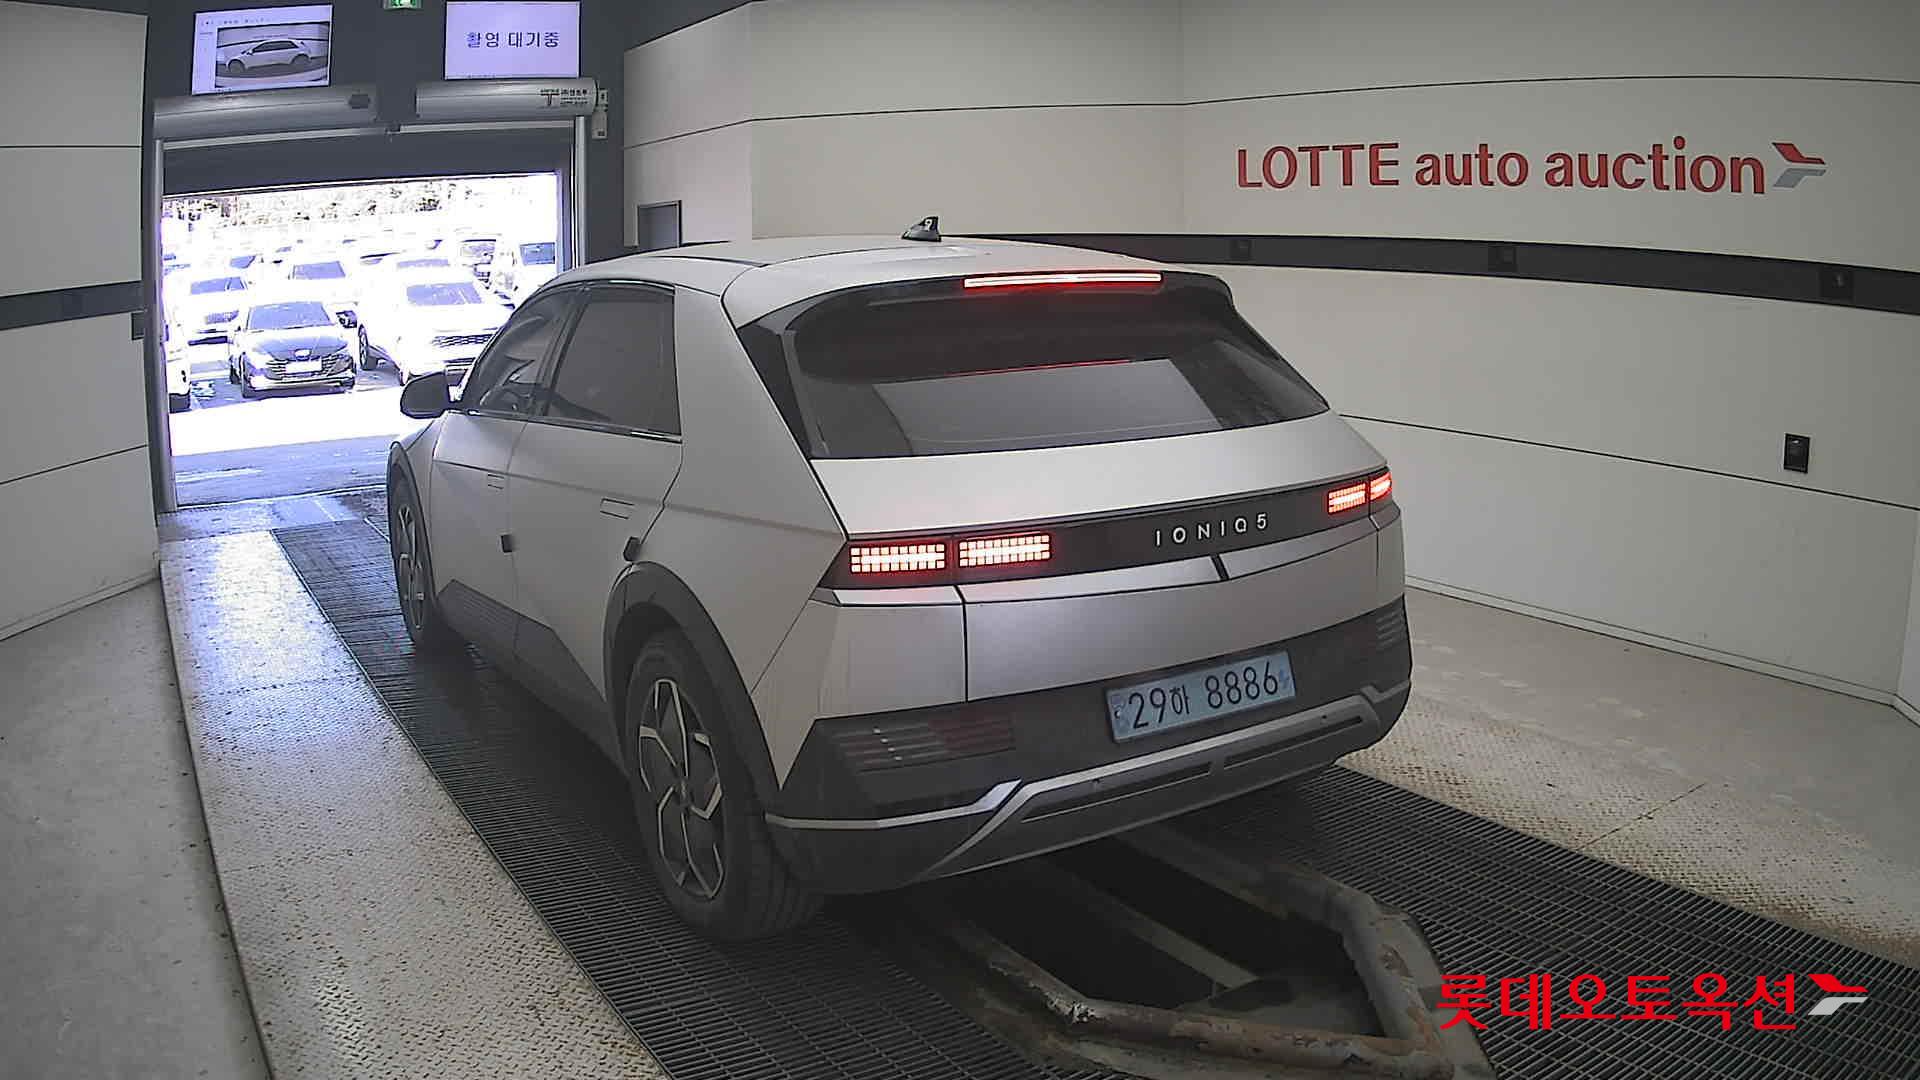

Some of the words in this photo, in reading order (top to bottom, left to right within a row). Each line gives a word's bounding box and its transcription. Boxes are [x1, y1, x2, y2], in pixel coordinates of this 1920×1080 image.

[508, 31, 560, 48] 대기중
[1237, 142, 1400, 189] LOTTE
[1415, 143, 1530, 187] auto
[1544, 135, 1765, 194] auction
[1128, 684, 1190, 729] 29하
[1204, 661, 1279, 709] 8886
